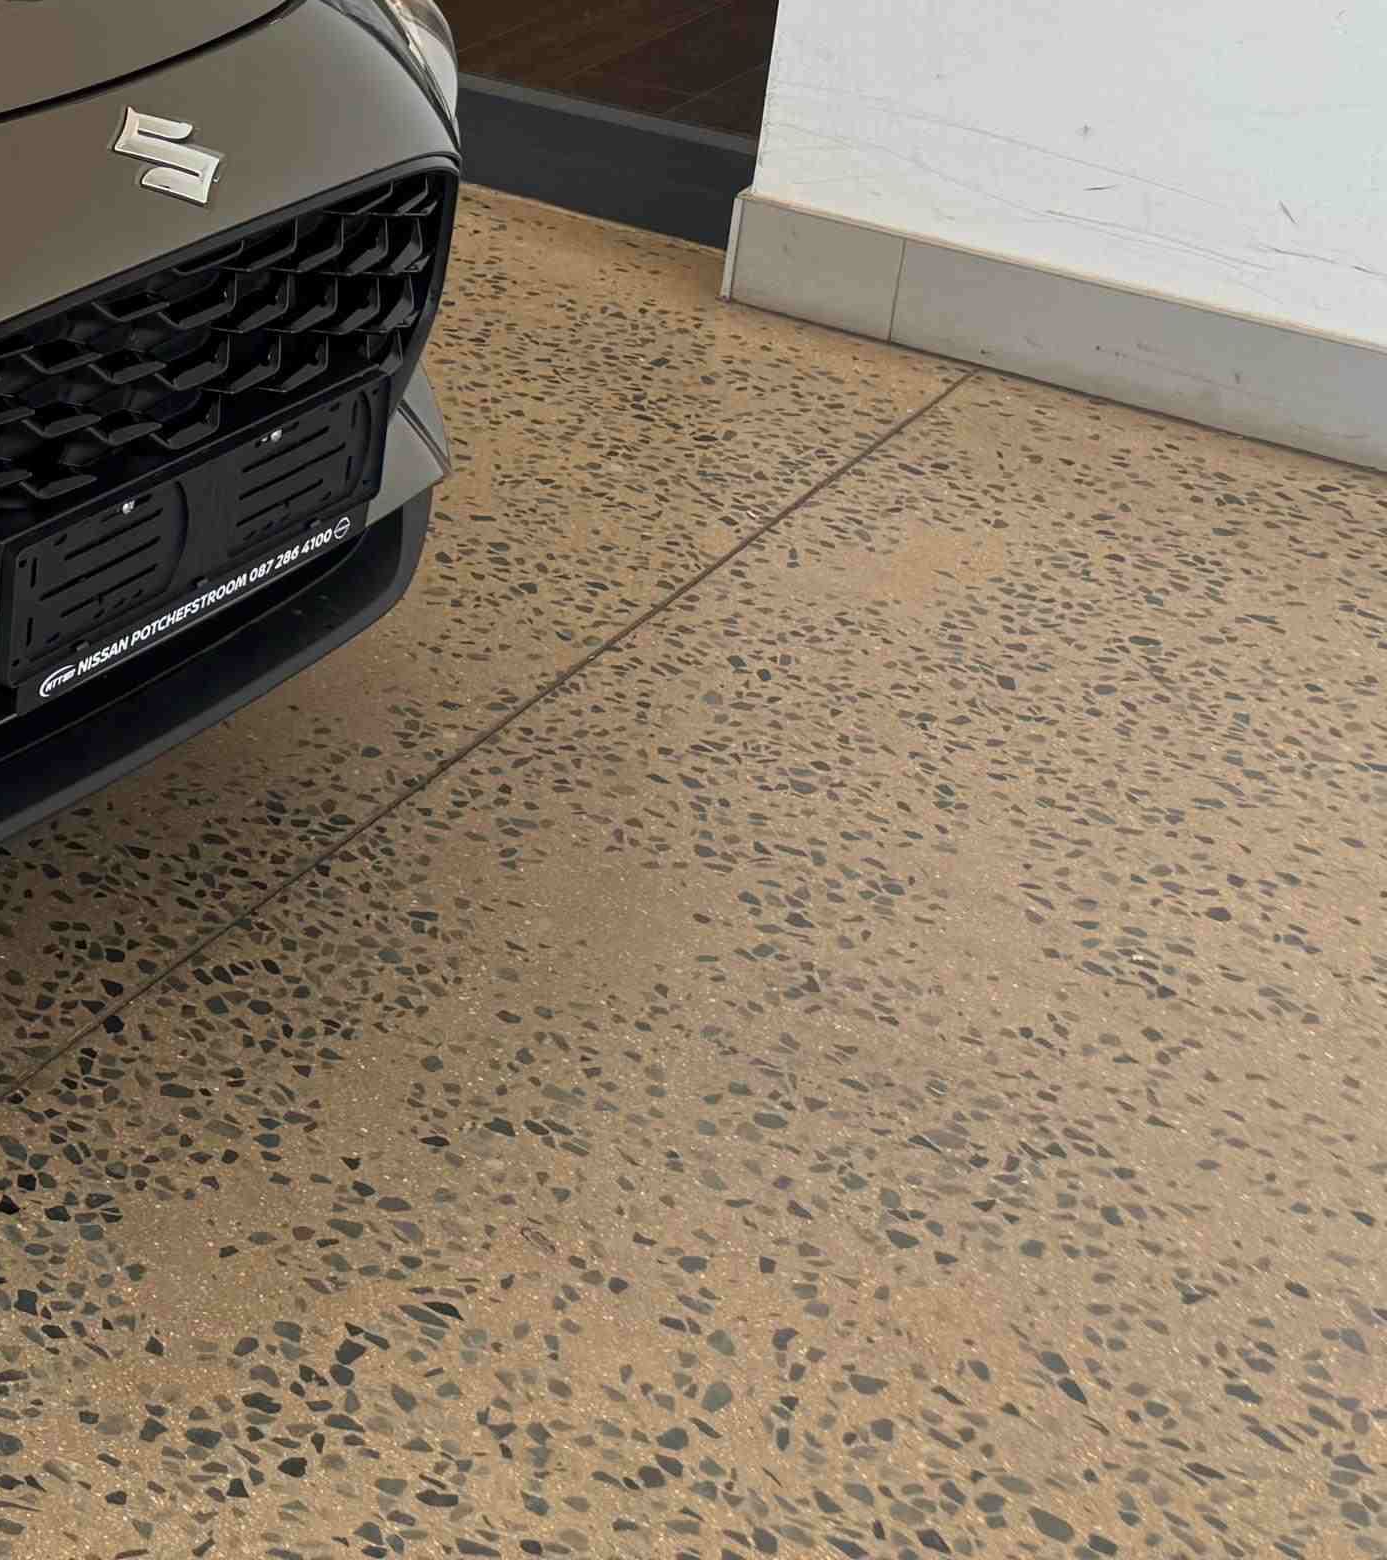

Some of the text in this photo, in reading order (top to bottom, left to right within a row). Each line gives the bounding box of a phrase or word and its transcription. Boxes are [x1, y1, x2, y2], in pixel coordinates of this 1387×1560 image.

[77, 636, 129, 676] NISSAN
[131, 573, 247, 646] POTCHEFSTROOM
[249, 559, 274, 582] 087
[274, 545, 300, 570] 286
[301, 528, 332, 555] 4100
